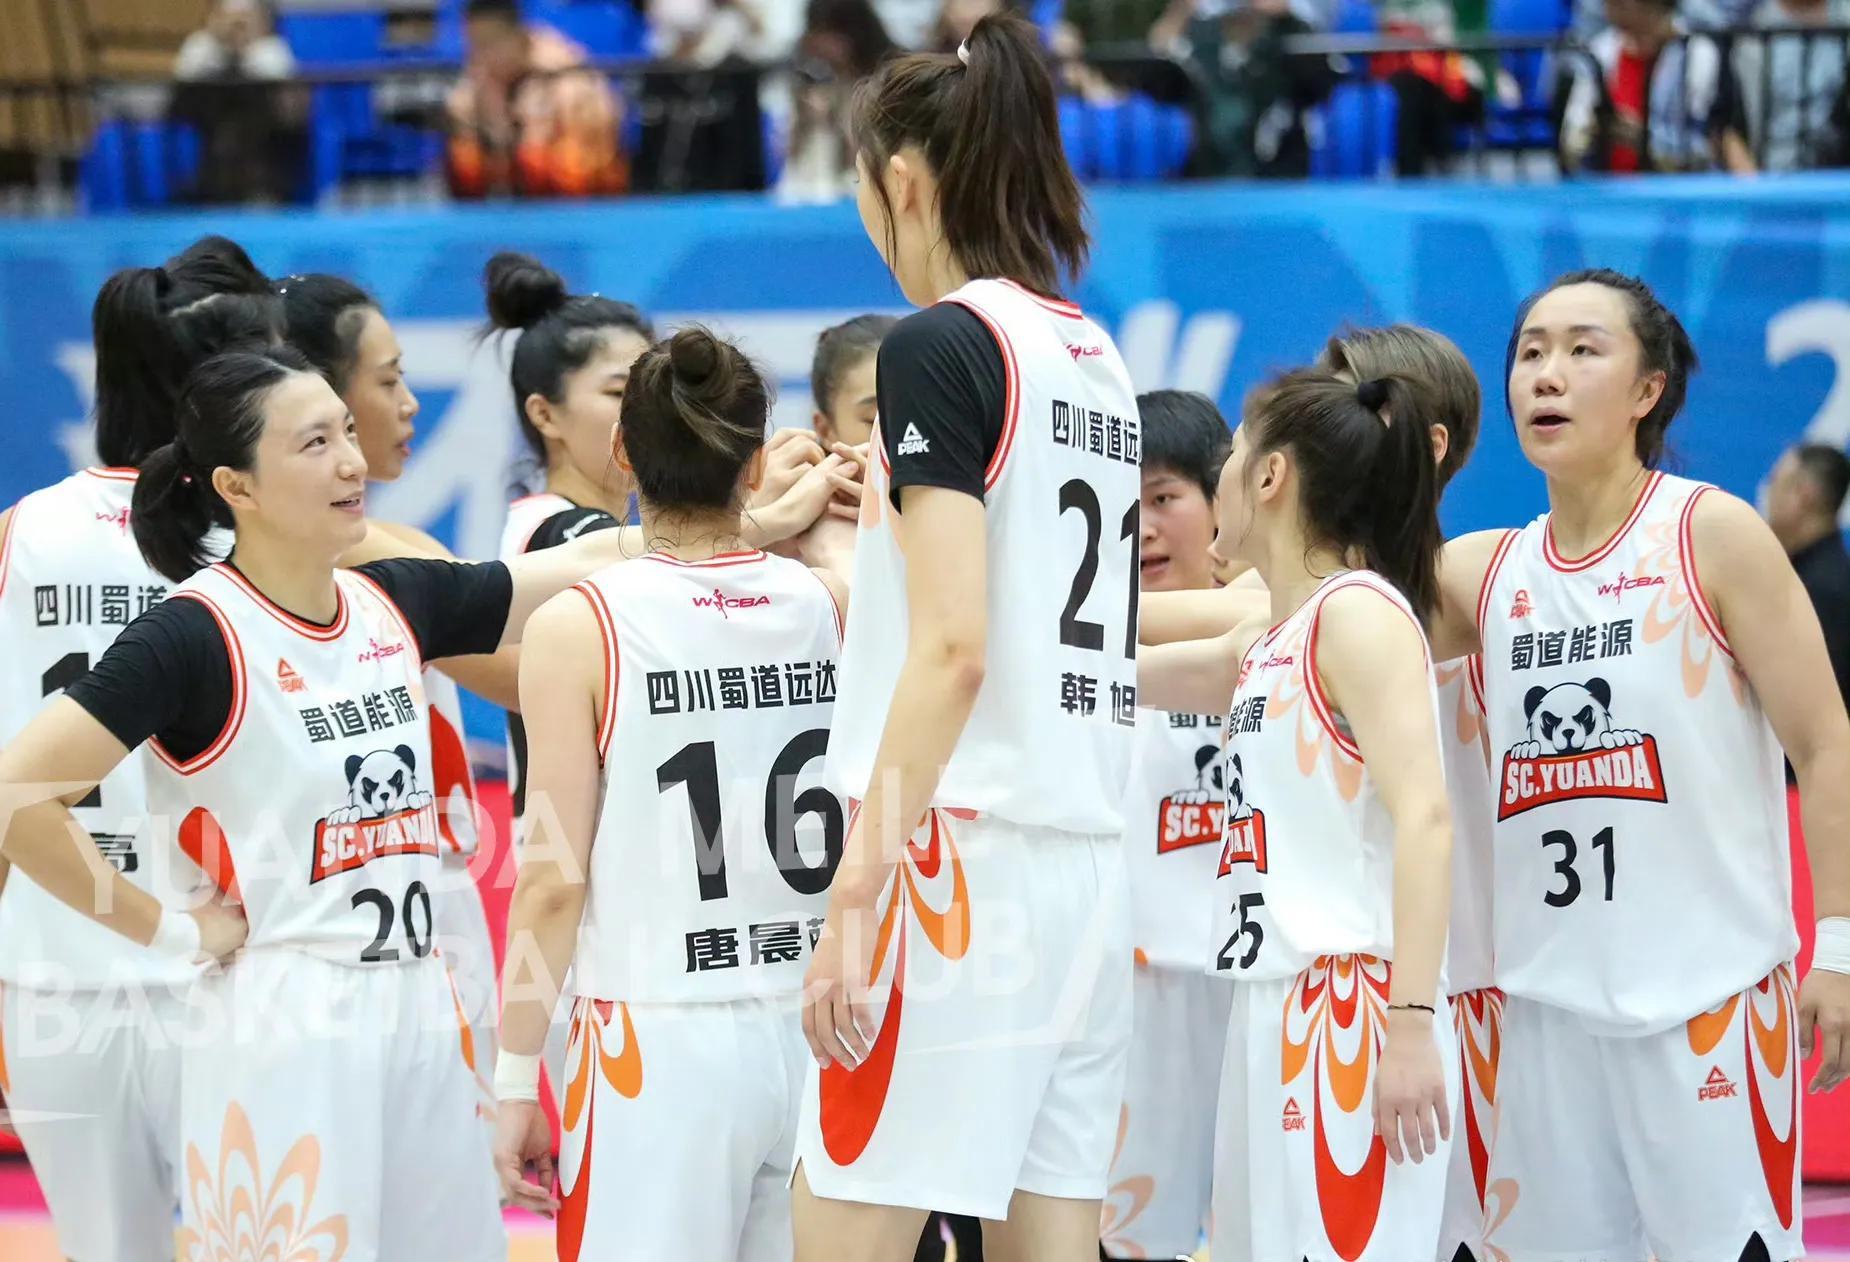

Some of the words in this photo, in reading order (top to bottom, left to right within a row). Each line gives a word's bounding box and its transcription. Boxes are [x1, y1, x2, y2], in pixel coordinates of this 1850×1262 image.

[897, 439, 930, 456] PEAK
[1052, 399, 1141, 467] 四川蜀道远
[1059, 478, 1140, 660] 21
[1598, 574, 1665, 600] WCBA
[691, 591, 771, 615] WCBA
[1511, 619, 1633, 671] 蜀道能源
[300, 686, 417, 743] 蜀道能源
[646, 659, 838, 715] 四川蜀道远达
[1505, 746, 1655, 805] SC.YUANDA
[656, 728, 844, 900] 16
[1541, 826, 1615, 908] 31
[351, 880, 432, 962] 20
[1698, 1082, 1738, 1101] PEAK
[1282, 1116, 1306, 1131] EAK
